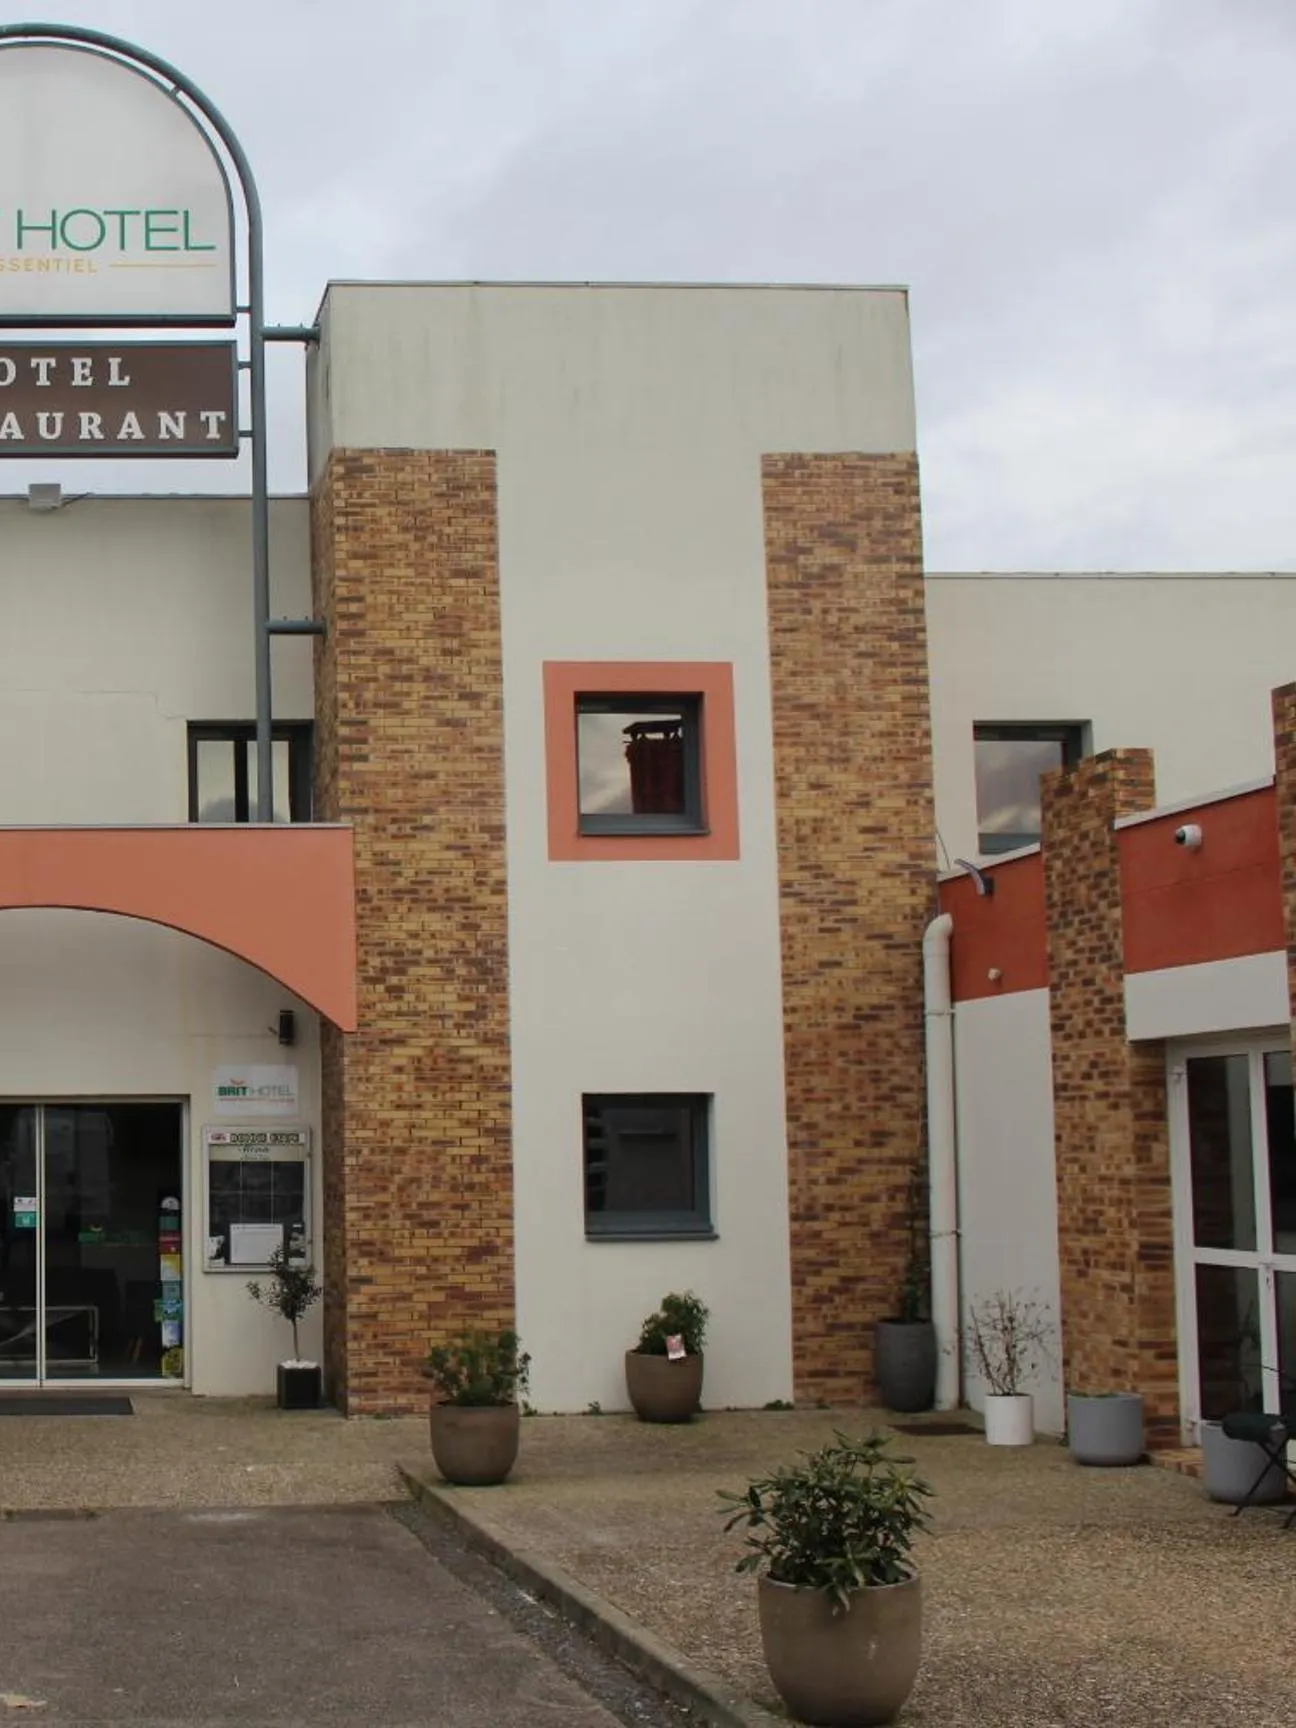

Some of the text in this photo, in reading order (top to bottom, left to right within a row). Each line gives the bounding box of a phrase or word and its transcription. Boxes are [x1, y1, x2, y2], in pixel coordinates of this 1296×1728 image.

[16, 208, 216, 251] HOTEL
[218, 1085, 294, 1096] BRIT HOTEL
